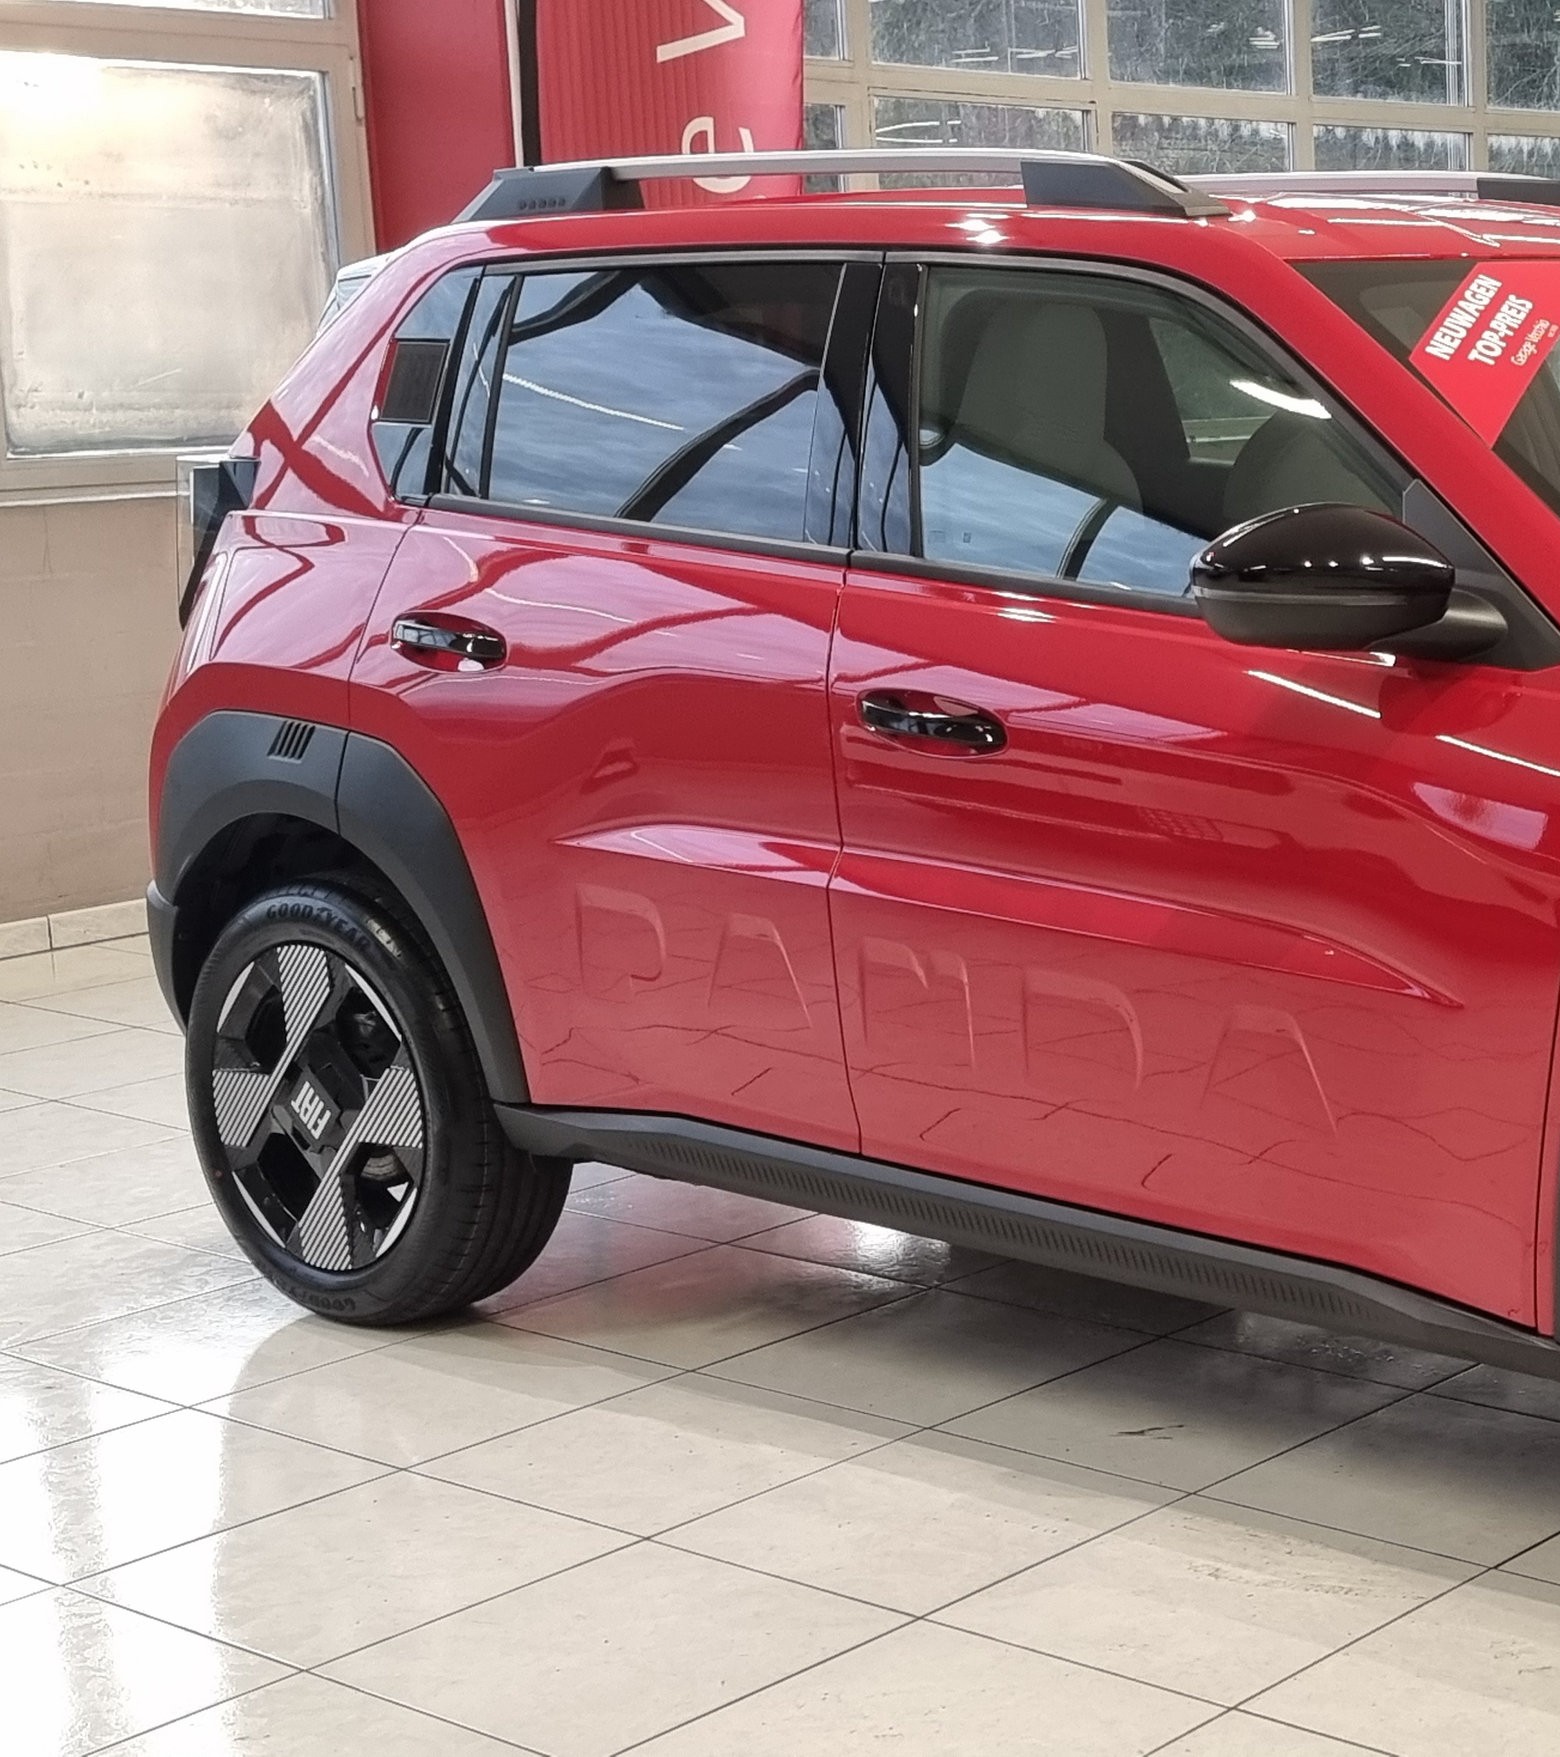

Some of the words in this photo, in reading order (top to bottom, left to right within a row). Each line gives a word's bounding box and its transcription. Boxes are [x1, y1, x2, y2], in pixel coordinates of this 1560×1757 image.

[1424, 273, 1503, 361] NEUWAGEN
[1467, 293, 1534, 366] TOP-PREIS
[289, 1079, 330, 1140] FIAT
